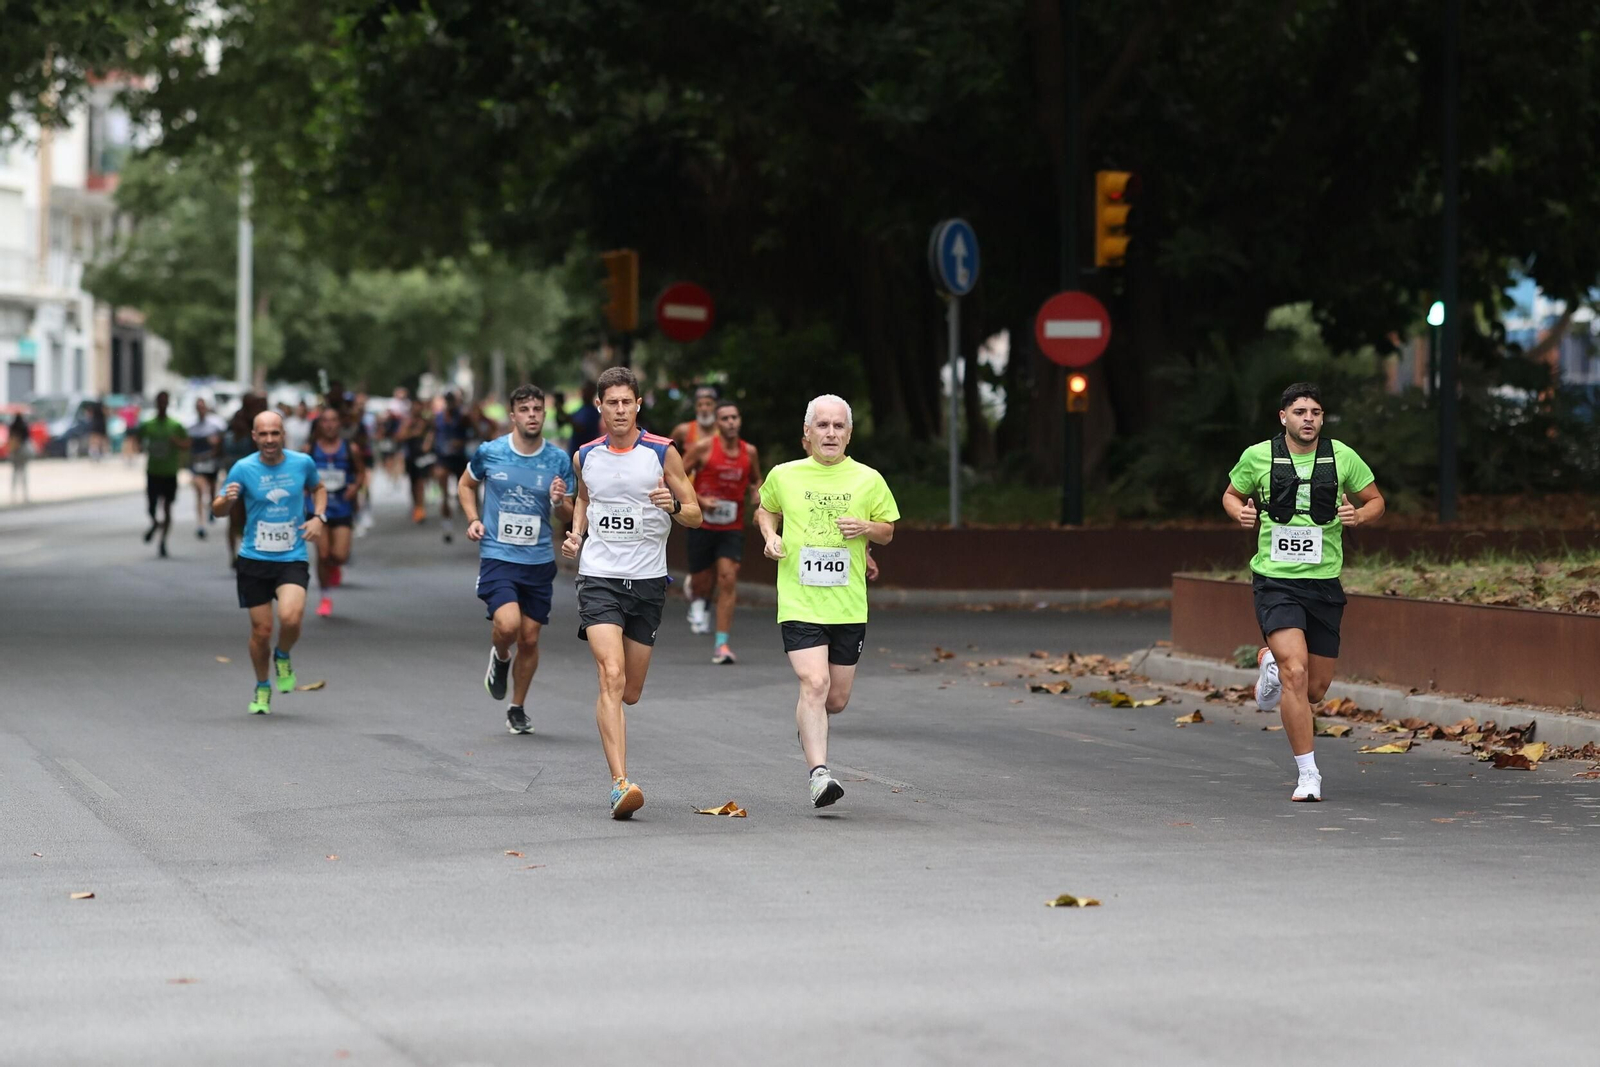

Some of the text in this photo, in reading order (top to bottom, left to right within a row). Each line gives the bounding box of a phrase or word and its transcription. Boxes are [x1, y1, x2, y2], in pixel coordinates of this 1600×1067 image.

[599, 516, 634, 530] 459
[261, 532, 289, 541] 1150
[504, 524, 533, 537] 678
[1278, 538, 1313, 552] 652
[804, 560, 844, 572] 1140
